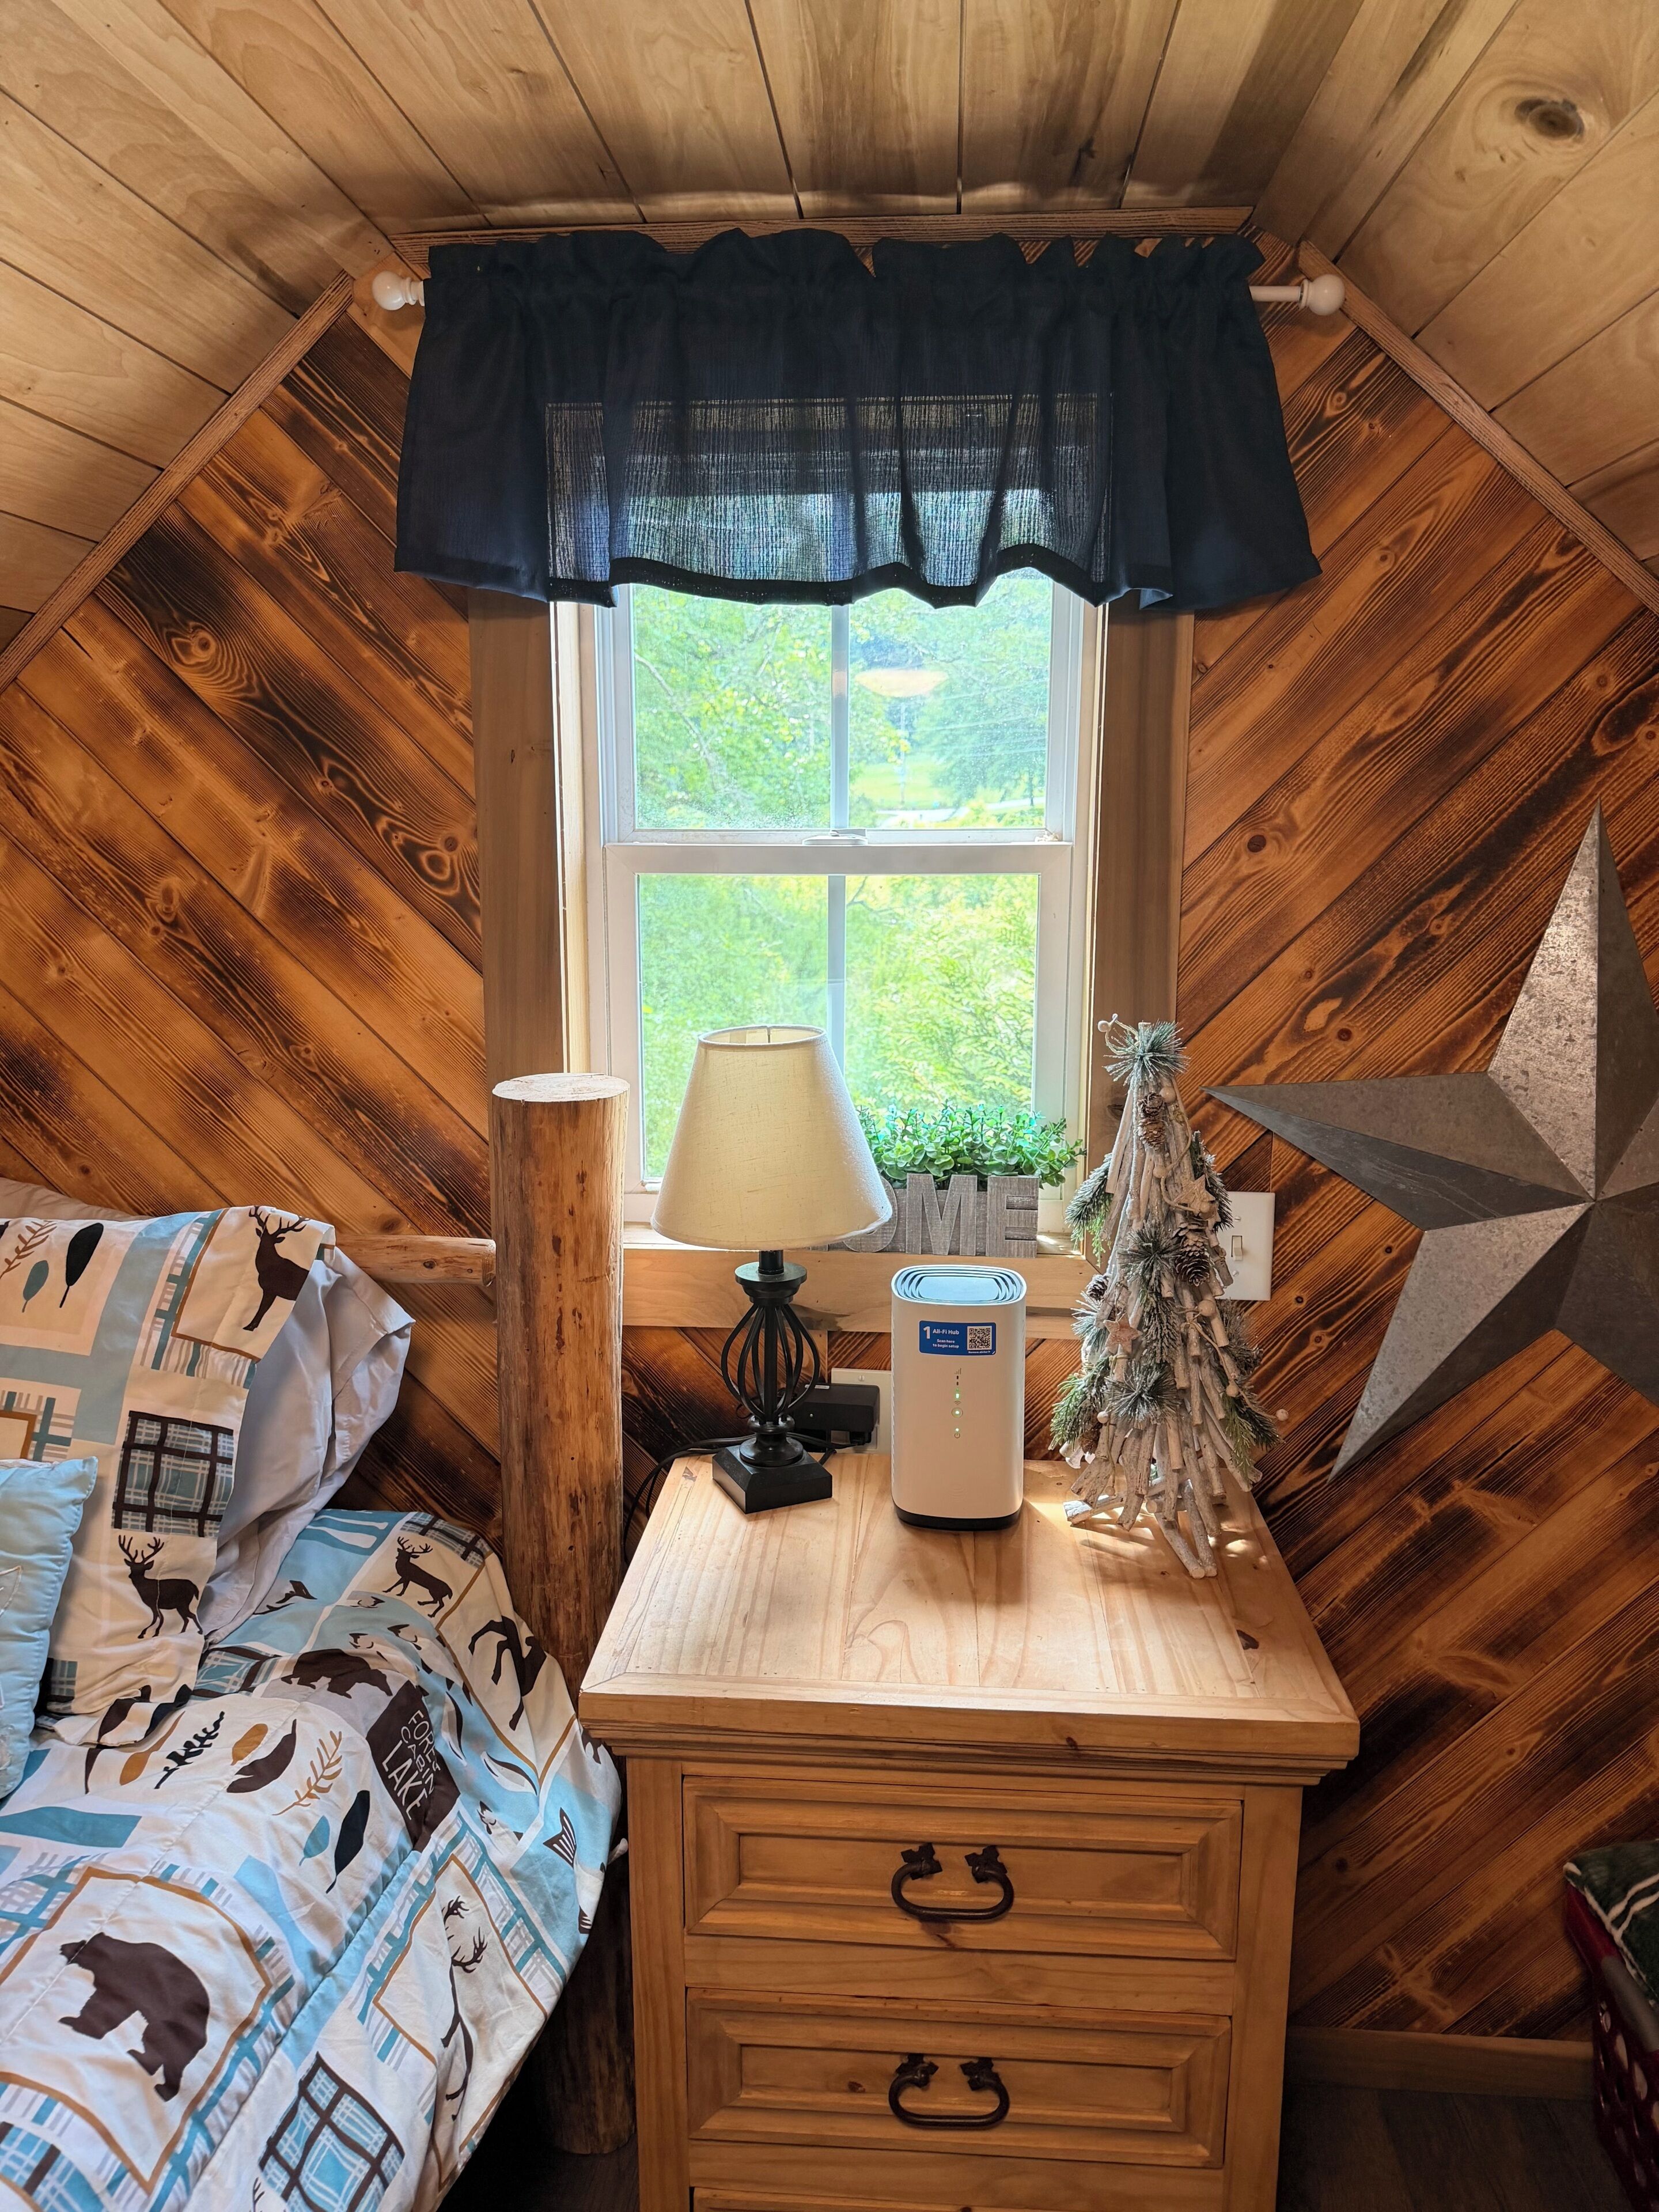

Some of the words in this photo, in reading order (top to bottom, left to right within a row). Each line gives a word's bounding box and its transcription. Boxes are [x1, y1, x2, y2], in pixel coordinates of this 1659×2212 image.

[923, 1326, 930, 1339] 1
[382, 1740, 429, 1820] LAKE
[400, 1726, 434, 1795] CABIN
